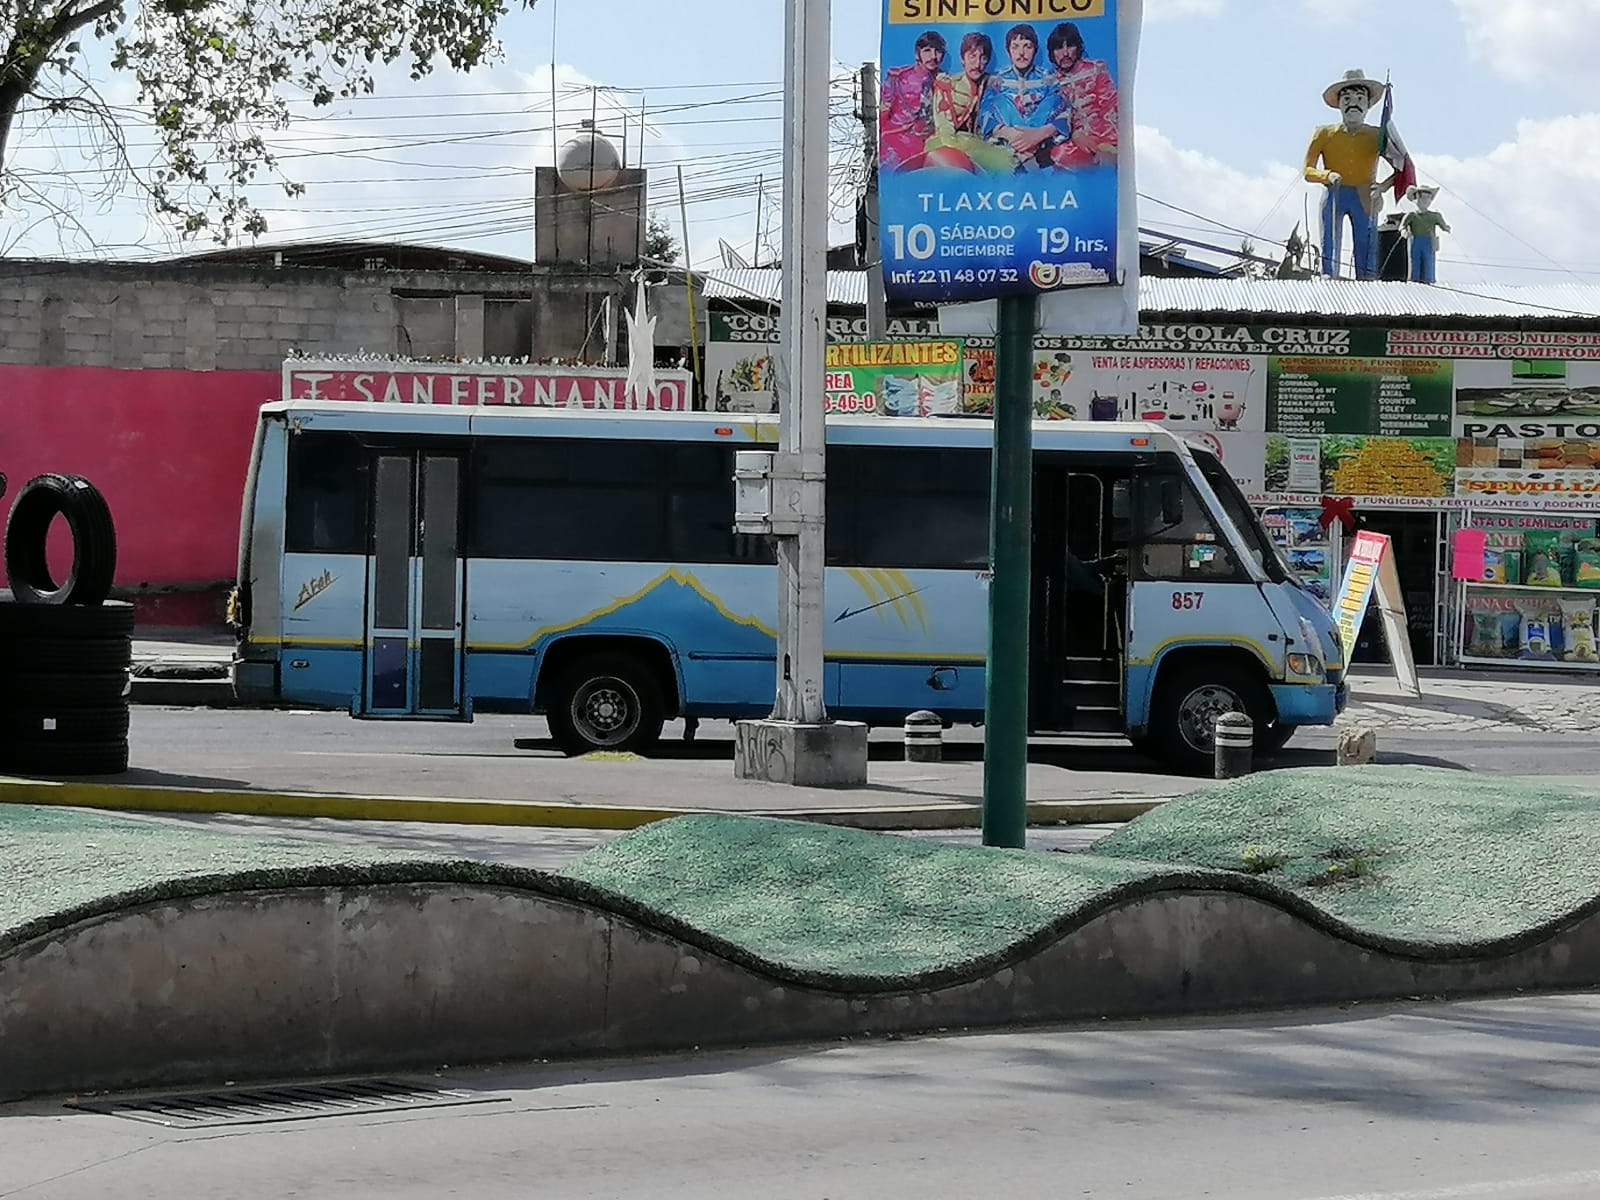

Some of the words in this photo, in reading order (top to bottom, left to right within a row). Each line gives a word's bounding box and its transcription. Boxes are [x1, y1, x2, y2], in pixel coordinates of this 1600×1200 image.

[918, 190, 1079, 213] TLAXCALA
[940, 223, 1016, 241] SÁBADO
[888, 223, 937, 261] 10
[1036, 227, 1070, 254] 19
[1074, 237, 1109, 253] hrs.
[940, 244, 1015, 257] DICIEMBRE
[918, 269, 937, 284] 22
[939, 269, 951, 284] 11
[954, 268, 975, 283] 48
[978, 268, 996, 283] 07
[1000, 268, 1019, 282] 32
[730, 331, 781, 341] SOLO
[1137, 325, 1255, 343] RICOLA
[1262, 327, 1350, 345] CRUZ
[1390, 330, 1489, 343] SERVIRLE
[1493, 332, 1520, 343] ES
[826, 342, 958, 367] RTILIZANTES
[1068, 339, 1107, 349] DEL
[1112, 340, 1185, 350] CAMPO
[1189, 341, 1242, 352] PARA
[1246, 343, 1273, 353] EL
[1277, 344, 1350, 354] CAMPO
[1389, 344, 1494, 356] PRINCIPAL
[1091, 356, 1118, 369] VENTA
[1121, 357, 1131, 369] DE
[1133, 357, 1186, 370] ASPERSORAS
[1188, 358, 1194, 370] Y
[1195, 358, 1251, 371] REFACCIONES
[353, 374, 434, 403] SAN
[825, 373, 852, 389] REA
[1463, 423, 1600, 438] PASTO
[1440, 499, 1529, 508] FERTILIZANTES
[1535, 500, 1542, 508] Y
[1455, 517, 1495, 528] VNTA
[1498, 517, 1514, 528] DE
[1519, 518, 1569, 529] SEMILLA
[1171, 591, 1205, 610] 857
